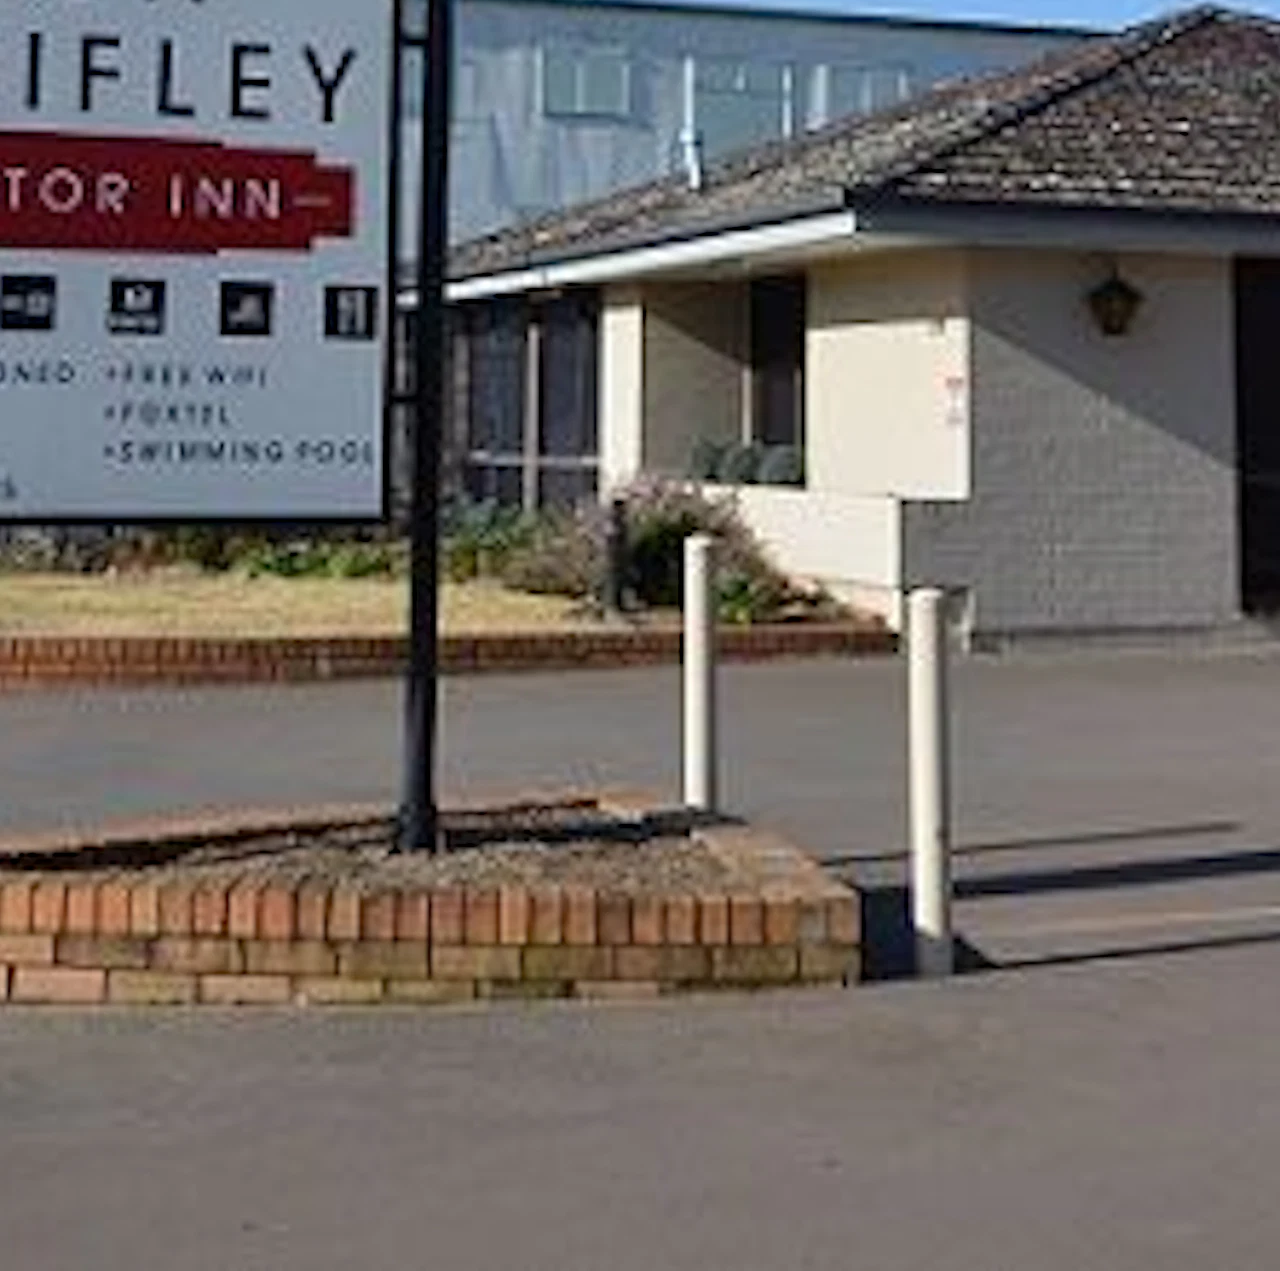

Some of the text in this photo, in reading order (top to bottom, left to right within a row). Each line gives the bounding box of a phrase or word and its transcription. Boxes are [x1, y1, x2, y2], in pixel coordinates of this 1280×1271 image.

[168, 172, 282, 220] INN
[121, 403, 230, 426] FOXTEL
[121, 439, 373, 464] SWIMMING POOL
